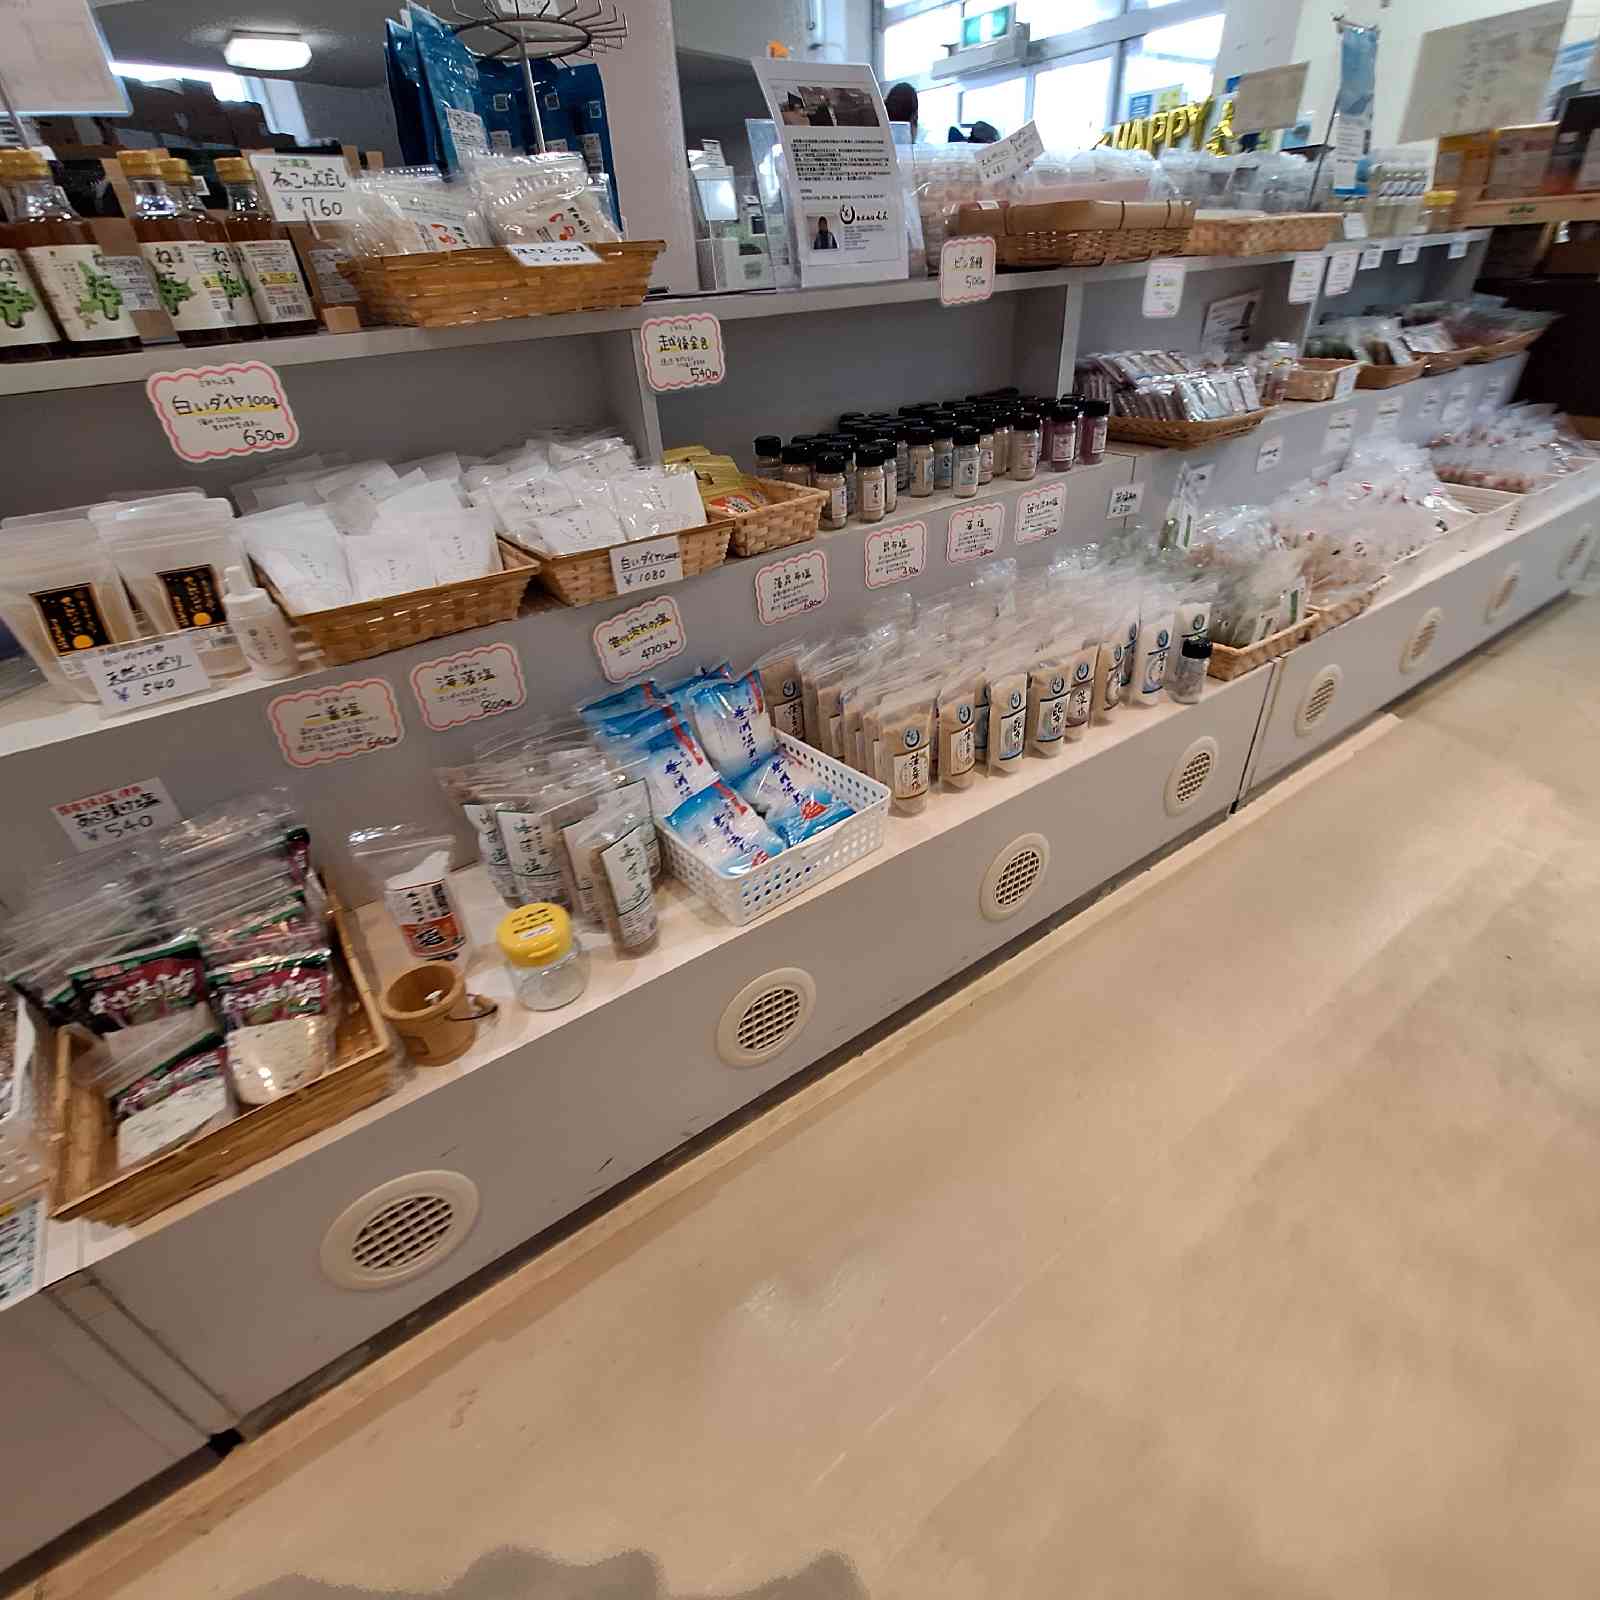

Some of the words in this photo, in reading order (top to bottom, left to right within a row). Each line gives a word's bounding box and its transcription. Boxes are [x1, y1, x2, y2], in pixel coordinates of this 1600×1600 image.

[172, 393, 281, 416] 白いダイヤ100g
[243, 429, 285, 446] 650円
